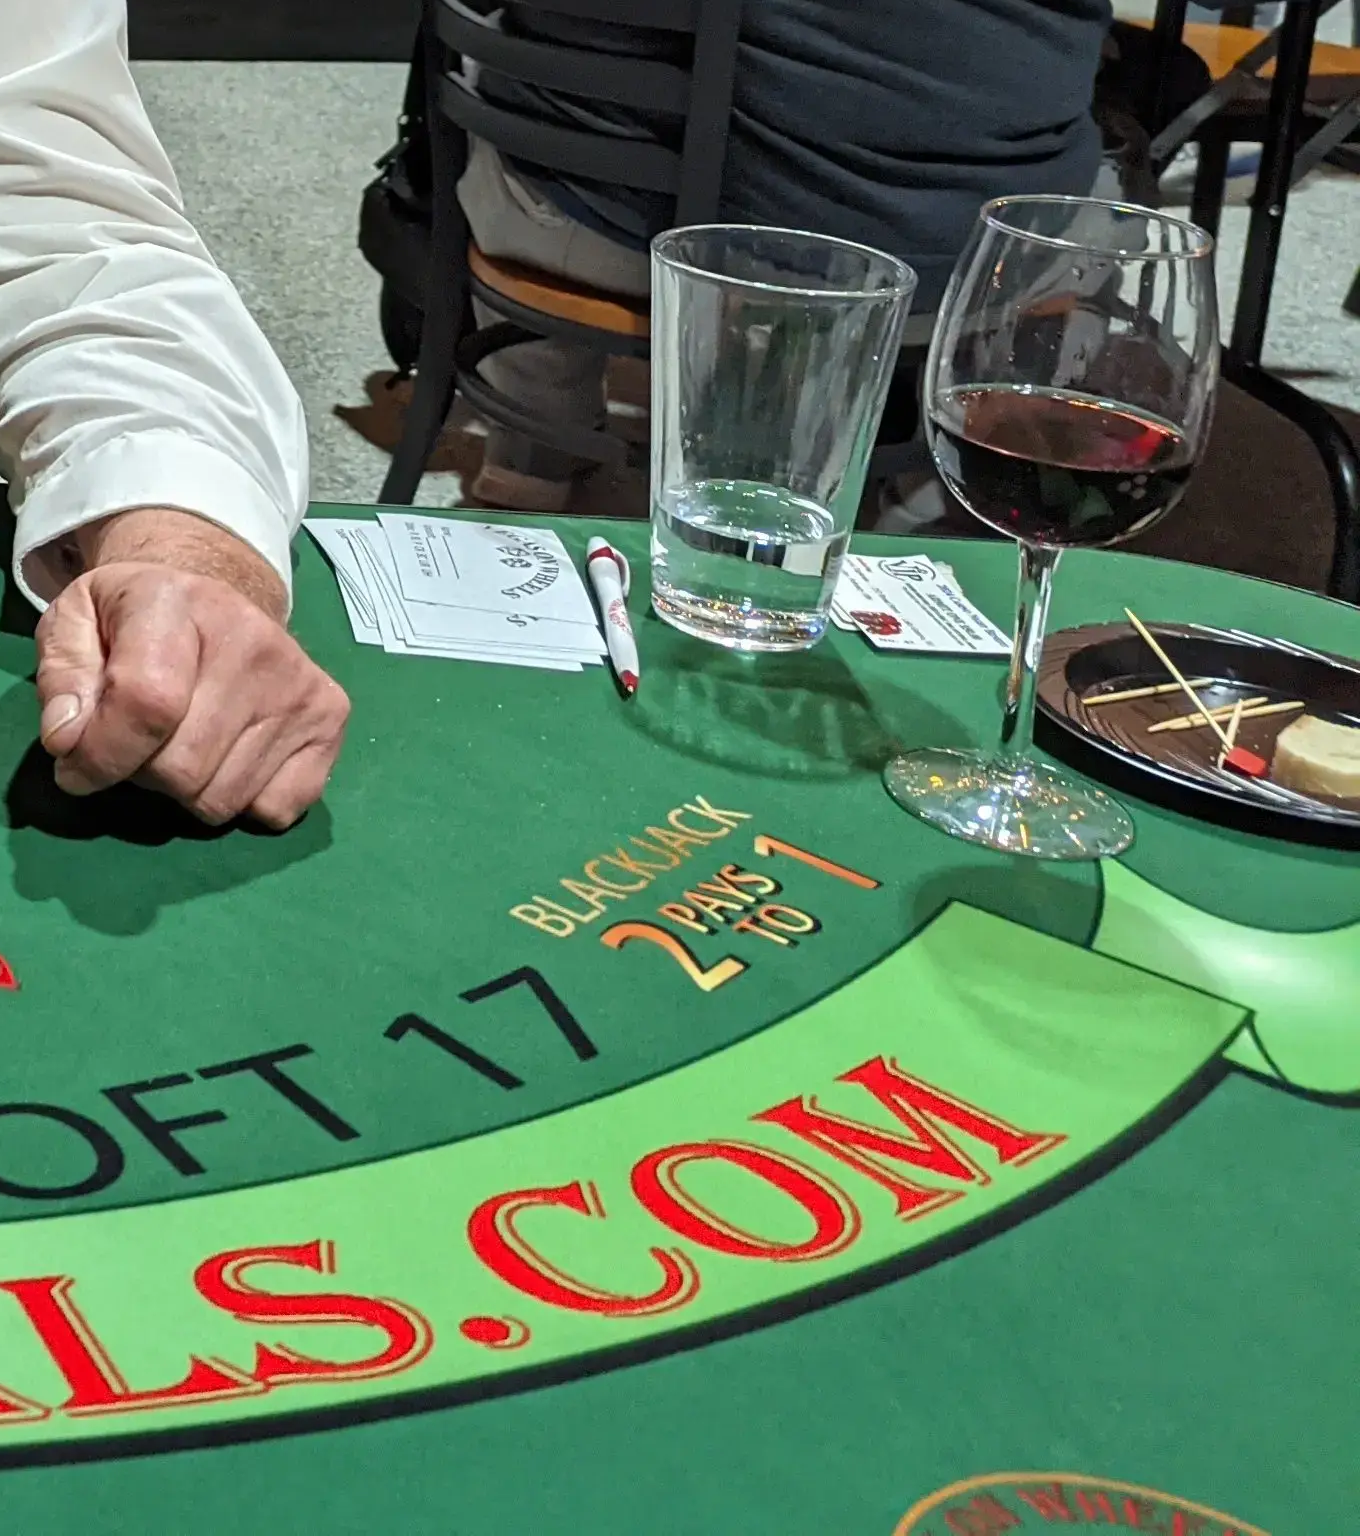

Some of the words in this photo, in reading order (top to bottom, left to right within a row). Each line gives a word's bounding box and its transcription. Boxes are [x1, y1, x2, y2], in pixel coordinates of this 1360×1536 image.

[501, 565, 560, 599] WHEELS
[507, 794, 755, 938] BLACKJACK
[753, 833, 882, 890] 1
[656, 863, 785, 937] PAYS
[732, 902, 823, 949] TO
[599, 918, 752, 993] 2
[382, 965, 600, 1093] 17
